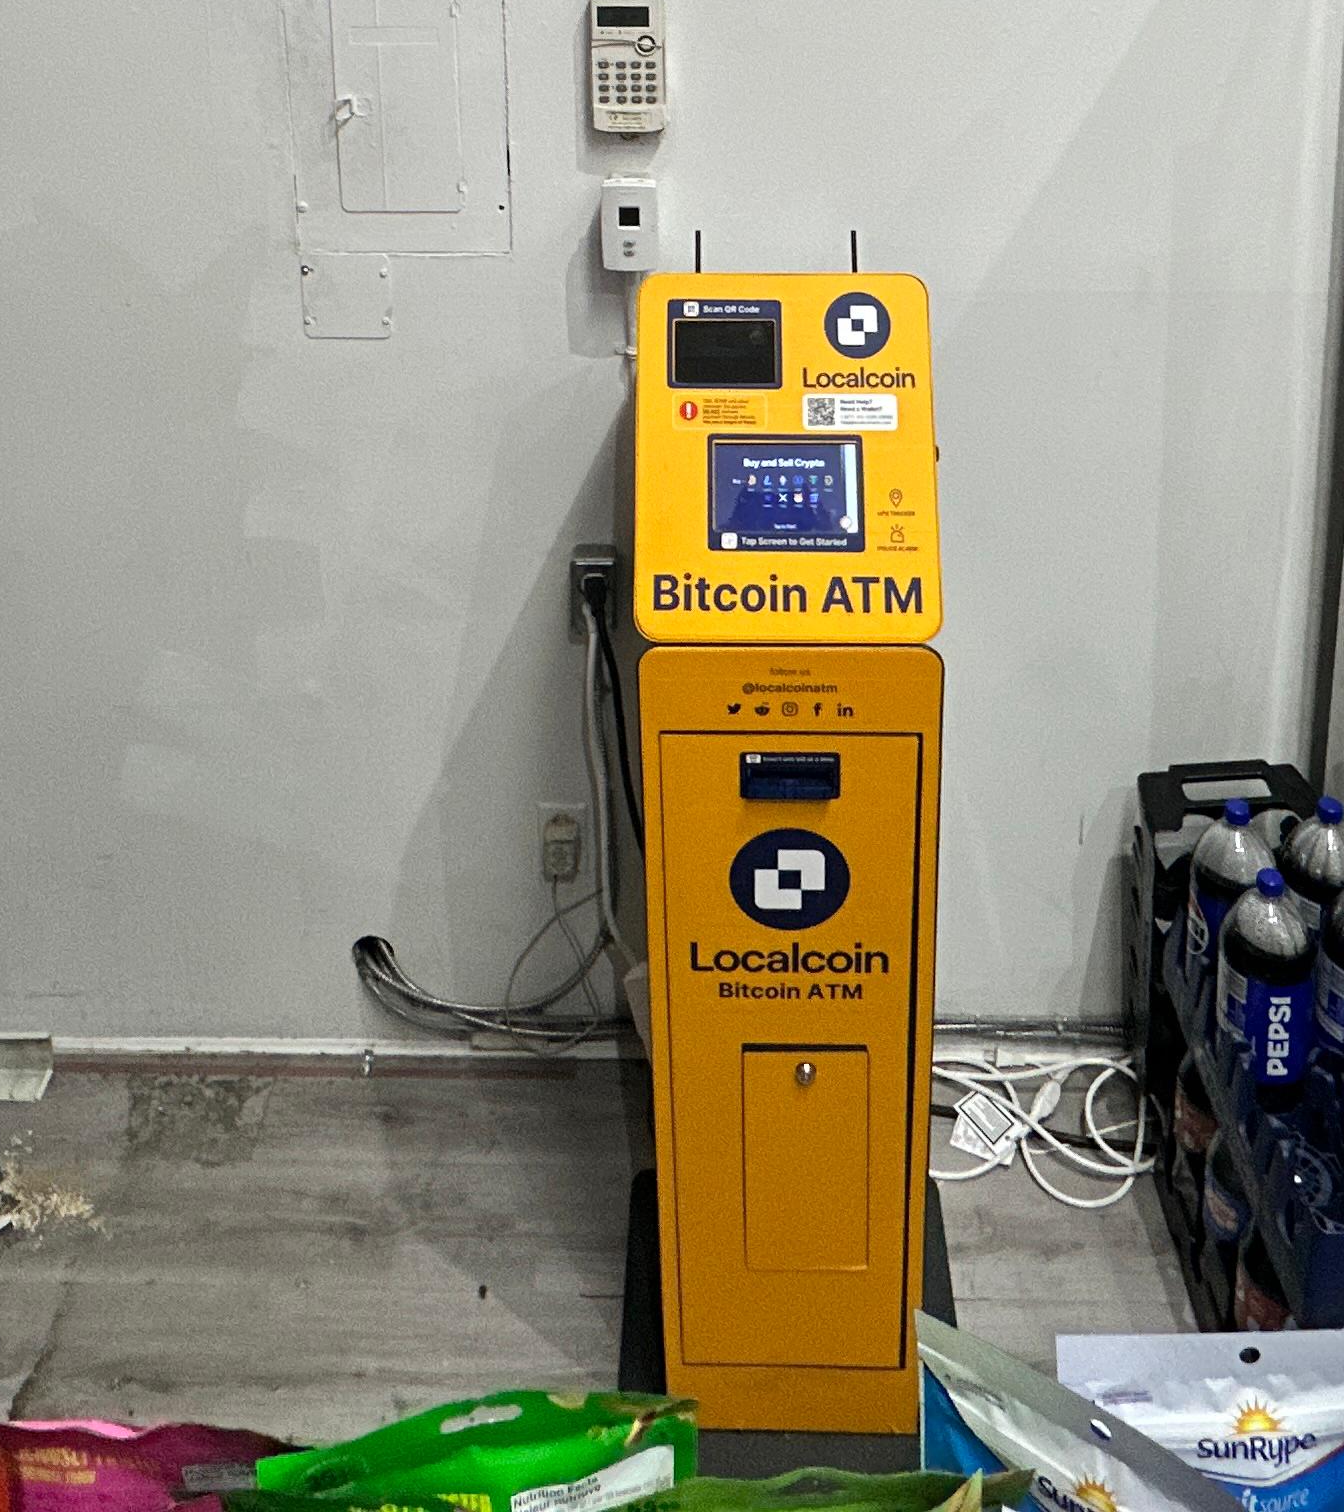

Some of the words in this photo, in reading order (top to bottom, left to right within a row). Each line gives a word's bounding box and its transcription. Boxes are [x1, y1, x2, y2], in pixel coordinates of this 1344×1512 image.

[703, 305, 723, 313] Scan
[725, 305, 737, 314] QR
[738, 305, 760, 314] Code
[802, 367, 916, 390] Localcoin
[743, 458, 759, 469] Buy
[761, 458, 777, 467] and
[778, 458, 793, 467] Sell
[794, 458, 825, 469] Crypto
[741, 538, 756, 547] Tap
[758, 537, 787, 546] Screen
[799, 538, 814, 546] Get
[816, 538, 847, 546] Started
[653, 573, 808, 613] Bitcoin
[821, 576, 925, 614] ATM
[742, 682, 838, 695] @localcoinatm
[690, 942, 890, 974] Localcoin
[718, 982, 801, 1000] Bitcoin
[807, 983, 863, 1000] ATM
[1266, 995, 1292, 1077] PEPSI
[1197, 1431, 1318, 1469] SunRype
